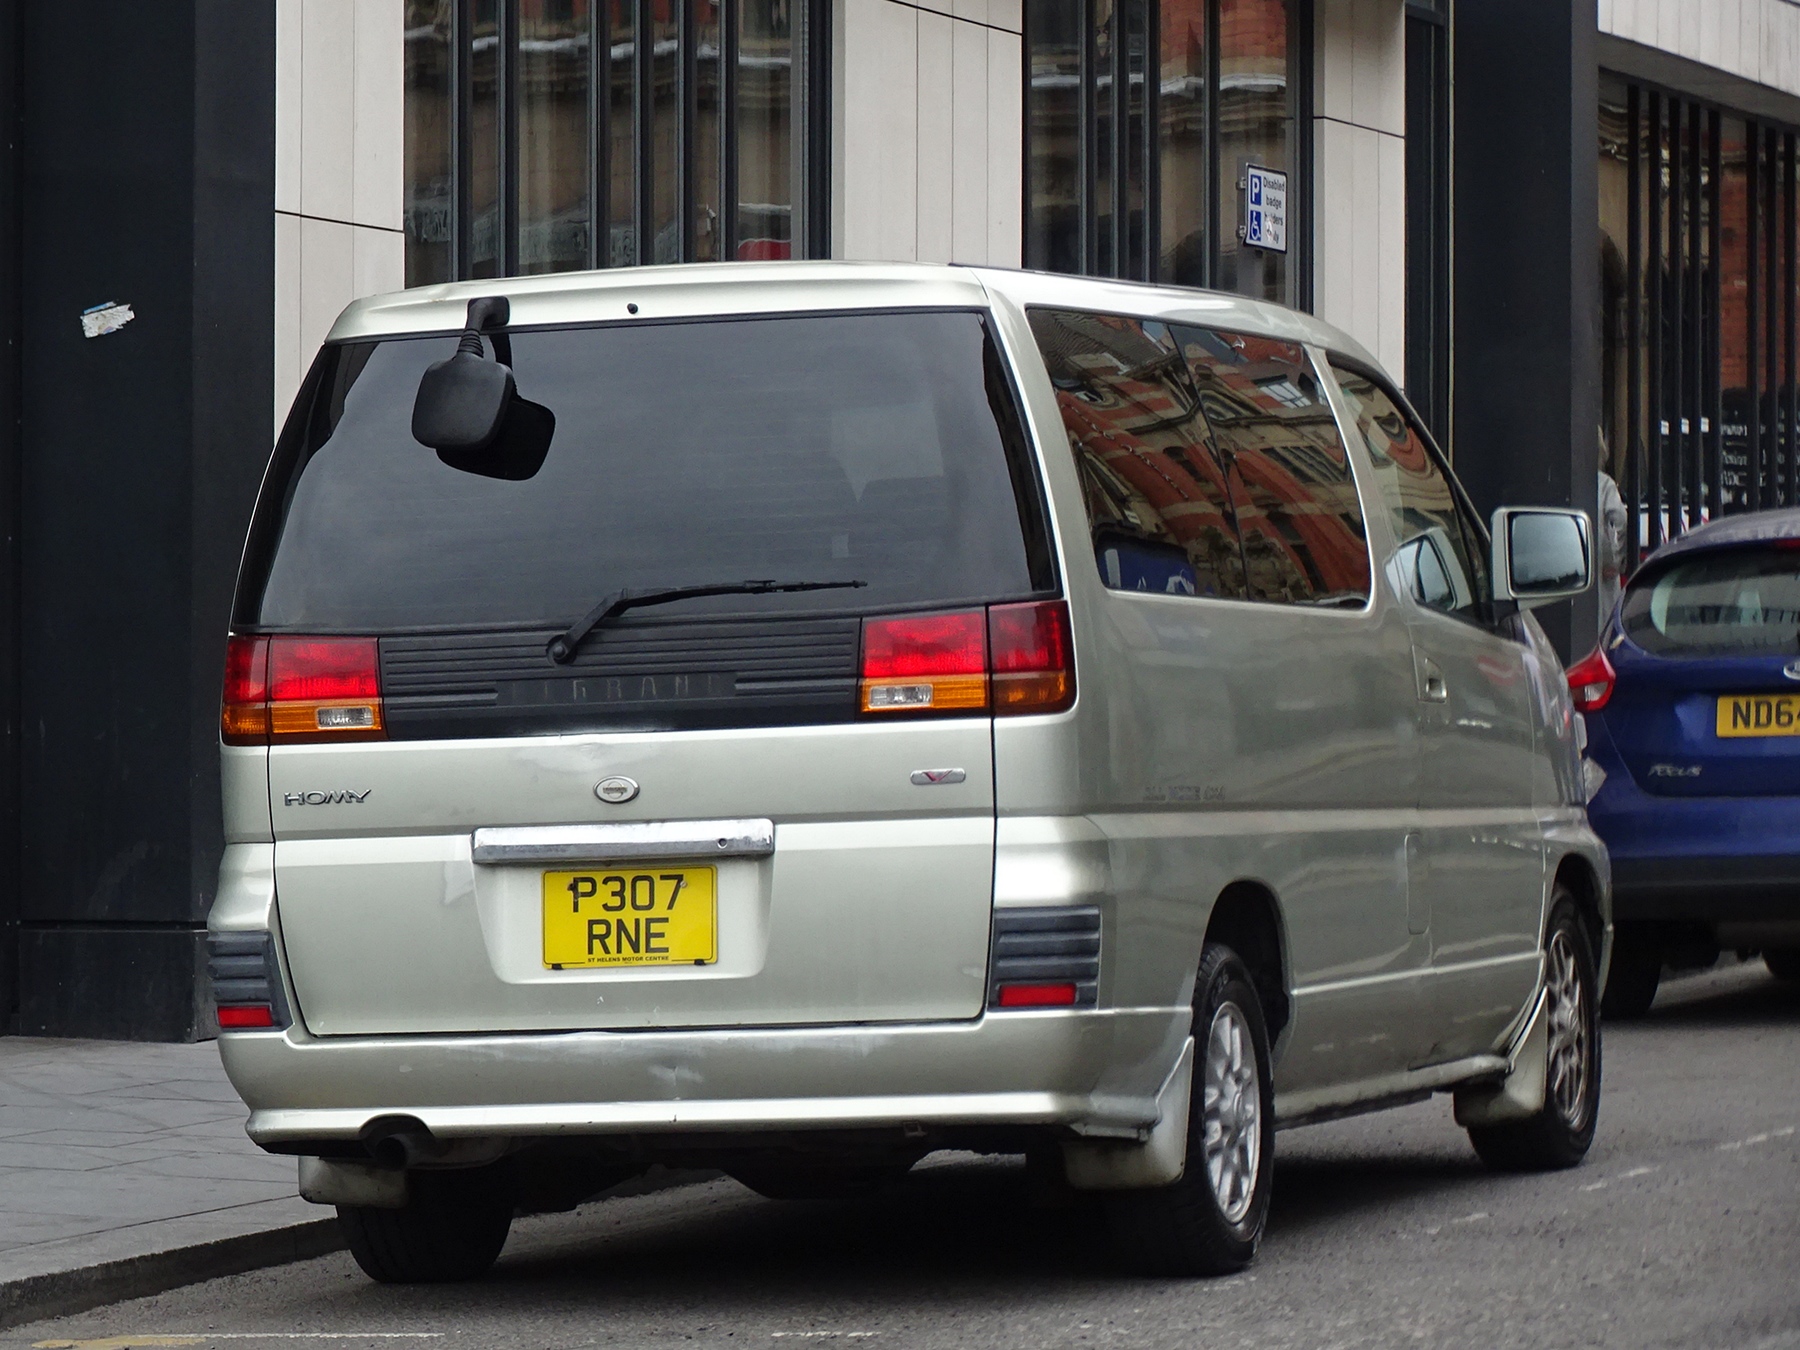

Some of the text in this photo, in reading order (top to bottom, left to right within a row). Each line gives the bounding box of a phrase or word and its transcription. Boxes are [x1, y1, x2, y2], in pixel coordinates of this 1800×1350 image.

[1252, 177, 1260, 202] P
[1263, 177, 1285, 192] Disabled
[1266, 195, 1282, 210] badge
[1264, 211, 1284, 226] hders
[1266, 228, 1280, 244] ly
[511, 674, 722, 704] GRAN
[1732, 700, 1800, 729] ND6
[284, 788, 372, 806] HOMY
[572, 874, 684, 913] P307
[587, 917, 670, 955] RNE
